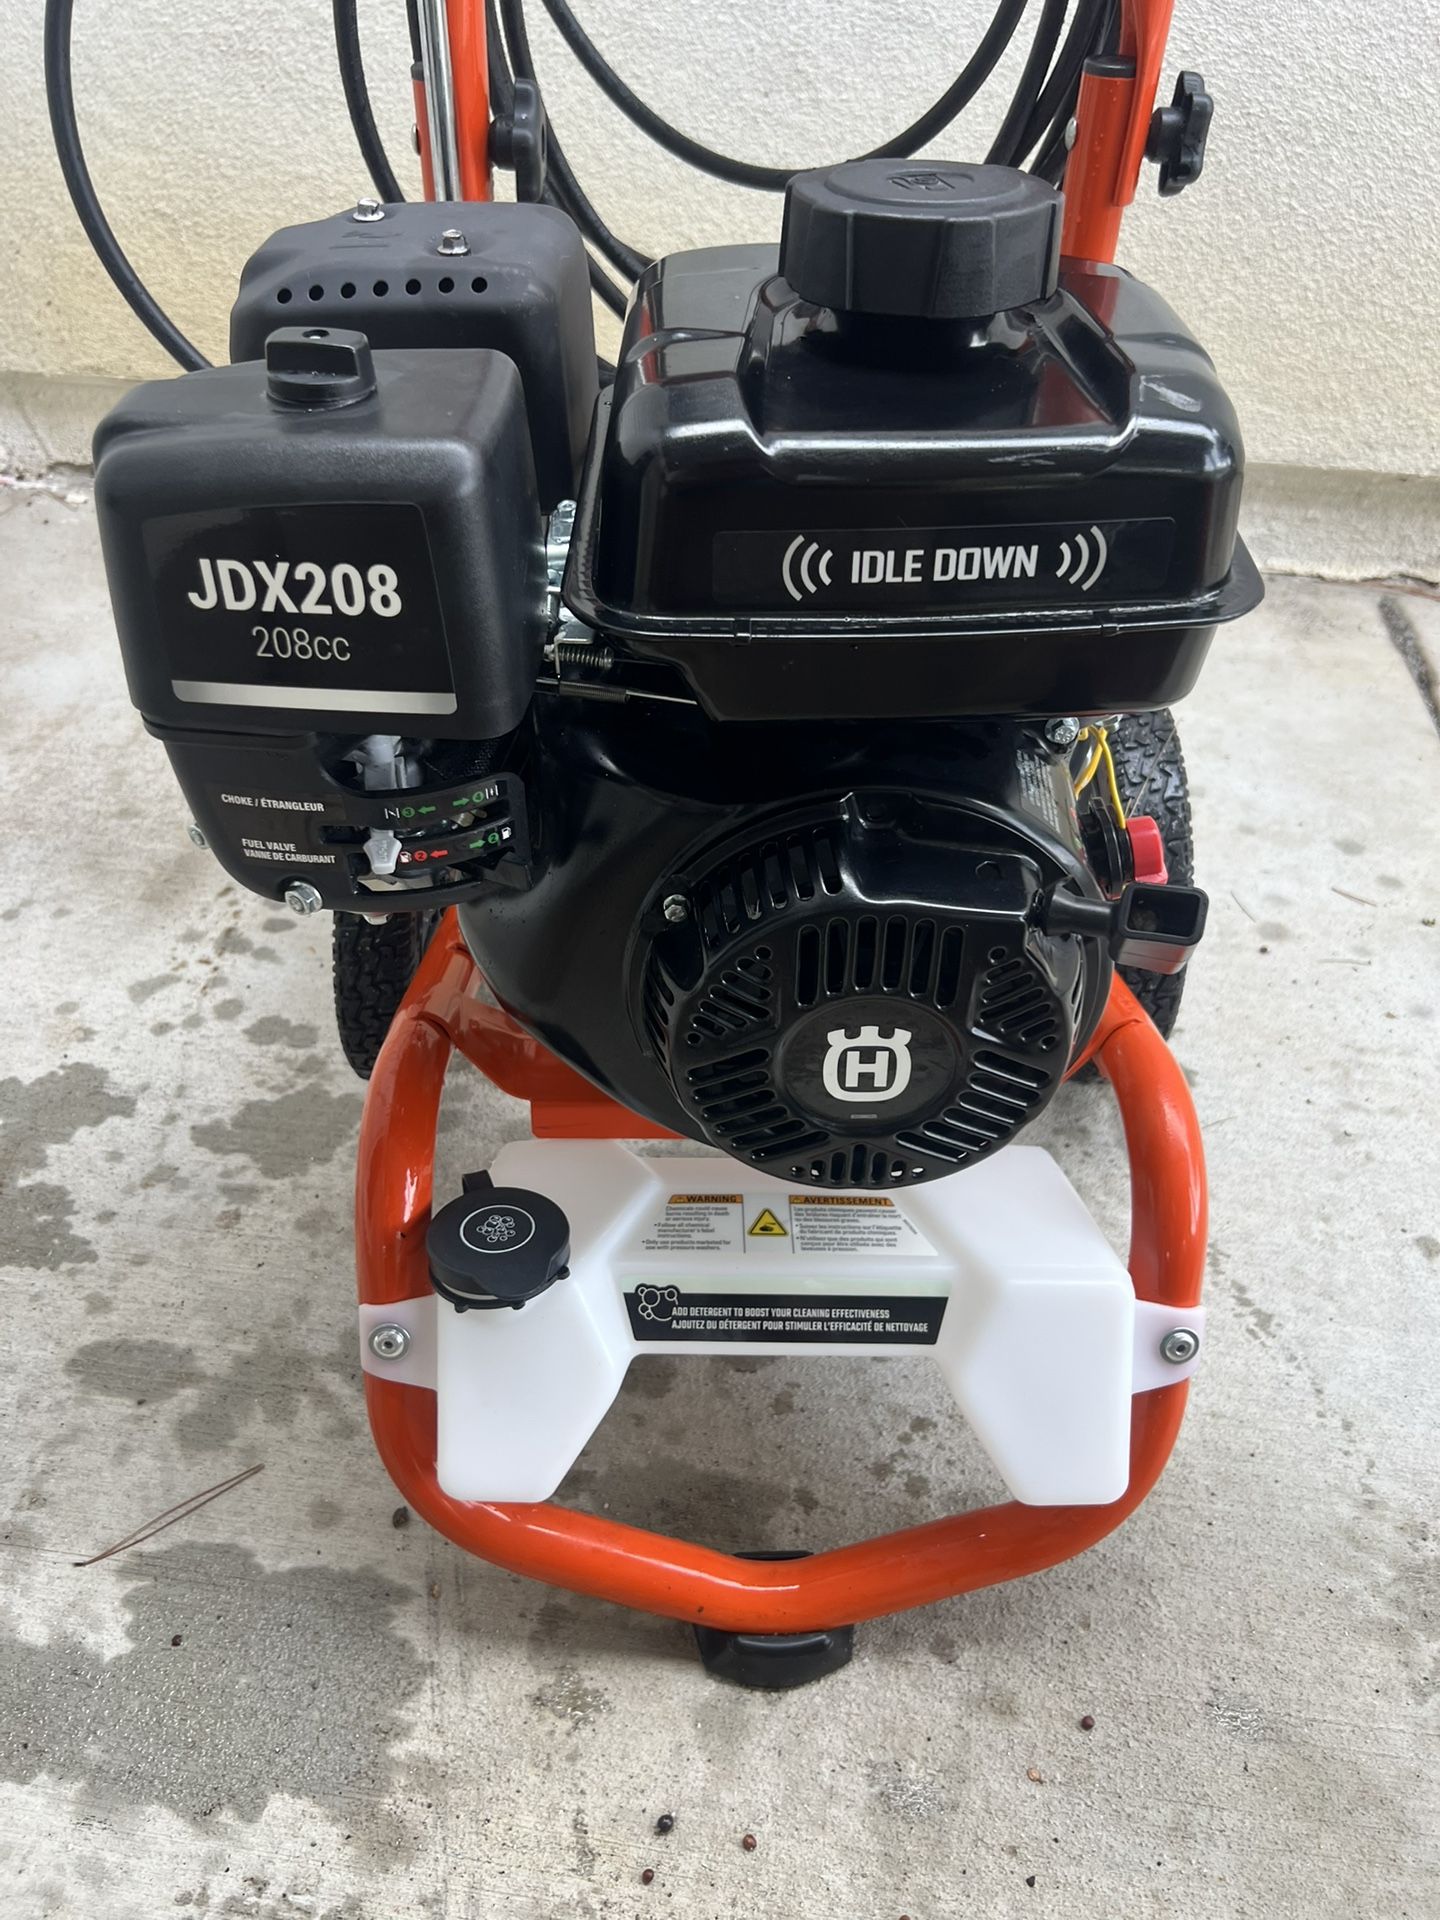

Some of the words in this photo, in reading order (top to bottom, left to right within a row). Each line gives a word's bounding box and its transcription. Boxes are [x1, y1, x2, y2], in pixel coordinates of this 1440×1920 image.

[851, 549, 924, 584] IDLE
[932, 544, 1039, 582] DOWN
[186, 557, 403, 618] JDX208
[251, 625, 351, 661] 208cc
[220, 794, 254, 806] CHOKE
[260, 797, 325, 812] ÉTRANGLEUR
[241, 838, 265, 850] FUEL
[266, 841, 297, 852] VALVE
[243, 848, 272, 860] VANNE
[273, 852, 285, 861] DE
[285, 853, 336, 864] CARBURANT
[845, 1050, 890, 1088] H
[686, 1194, 736, 1203] WARNING
[804, 1196, 888, 1206] AVERTISSEMENT
[672, 1306, 688, 1316] ADD
[690, 1307, 732, 1317] DETERGENT
[733, 1308, 743, 1316] TO
[744, 1308, 770, 1317] BOOST
[771, 1308, 792, 1318] YOUR
[792, 1308, 830, 1318] CLEANING
[831, 1309, 890, 1319] EFFECTIVENESS
[671, 1320, 705, 1329] AJOUTEZ
[706, 1320, 717, 1330] DU
[718, 1319, 761, 1330] DÉTERGENT
[762, 1320, 783, 1330] POUR
[784, 1321, 822, 1331] STIMULER
[824, 1320, 872, 1332] L'EFFICACITÉ
[874, 1322, 884, 1332] DE
[885, 1322, 928, 1332] NETTOYAGE
